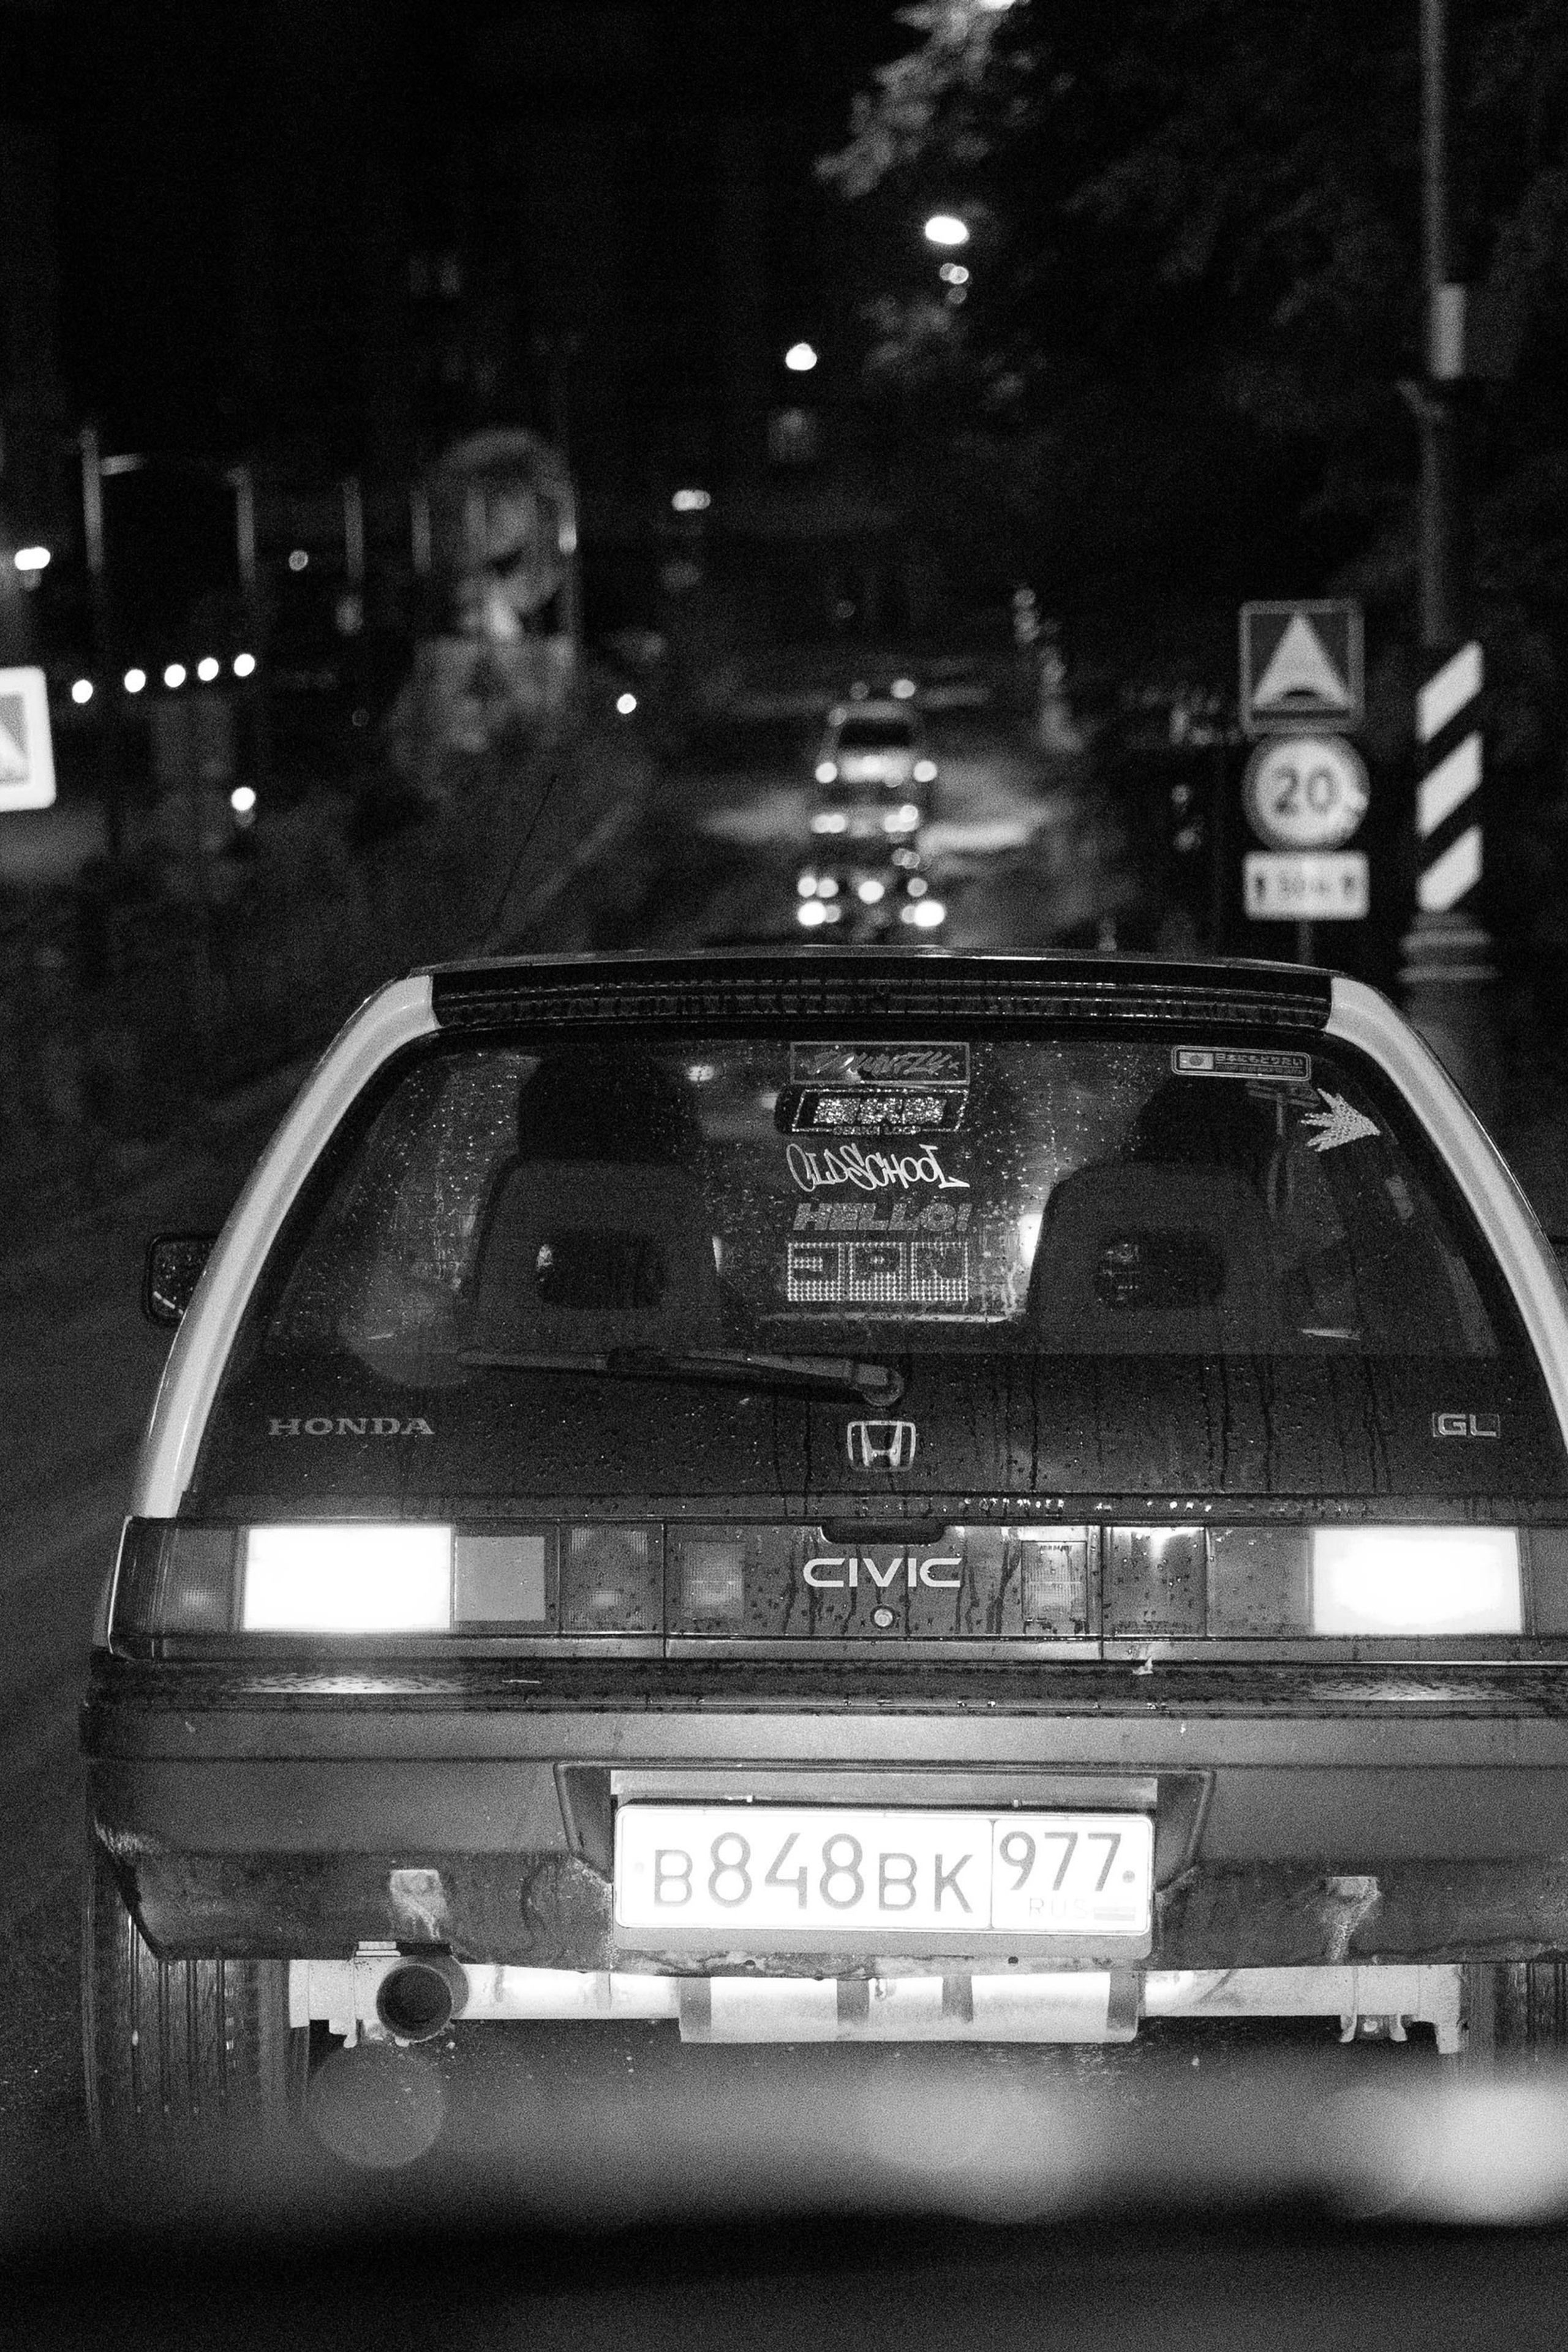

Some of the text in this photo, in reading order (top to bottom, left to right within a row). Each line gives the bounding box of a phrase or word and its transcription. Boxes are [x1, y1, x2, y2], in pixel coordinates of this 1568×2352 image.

[1272, 764, 1338, 818] 20
[268, 1417, 435, 1435] HONDA
[1438, 1413, 1497, 1436] GL
[803, 1558, 962, 1587] CIVIC
[998, 1830, 1123, 1892] 977
[1028, 1897, 1089, 1920] RUS
